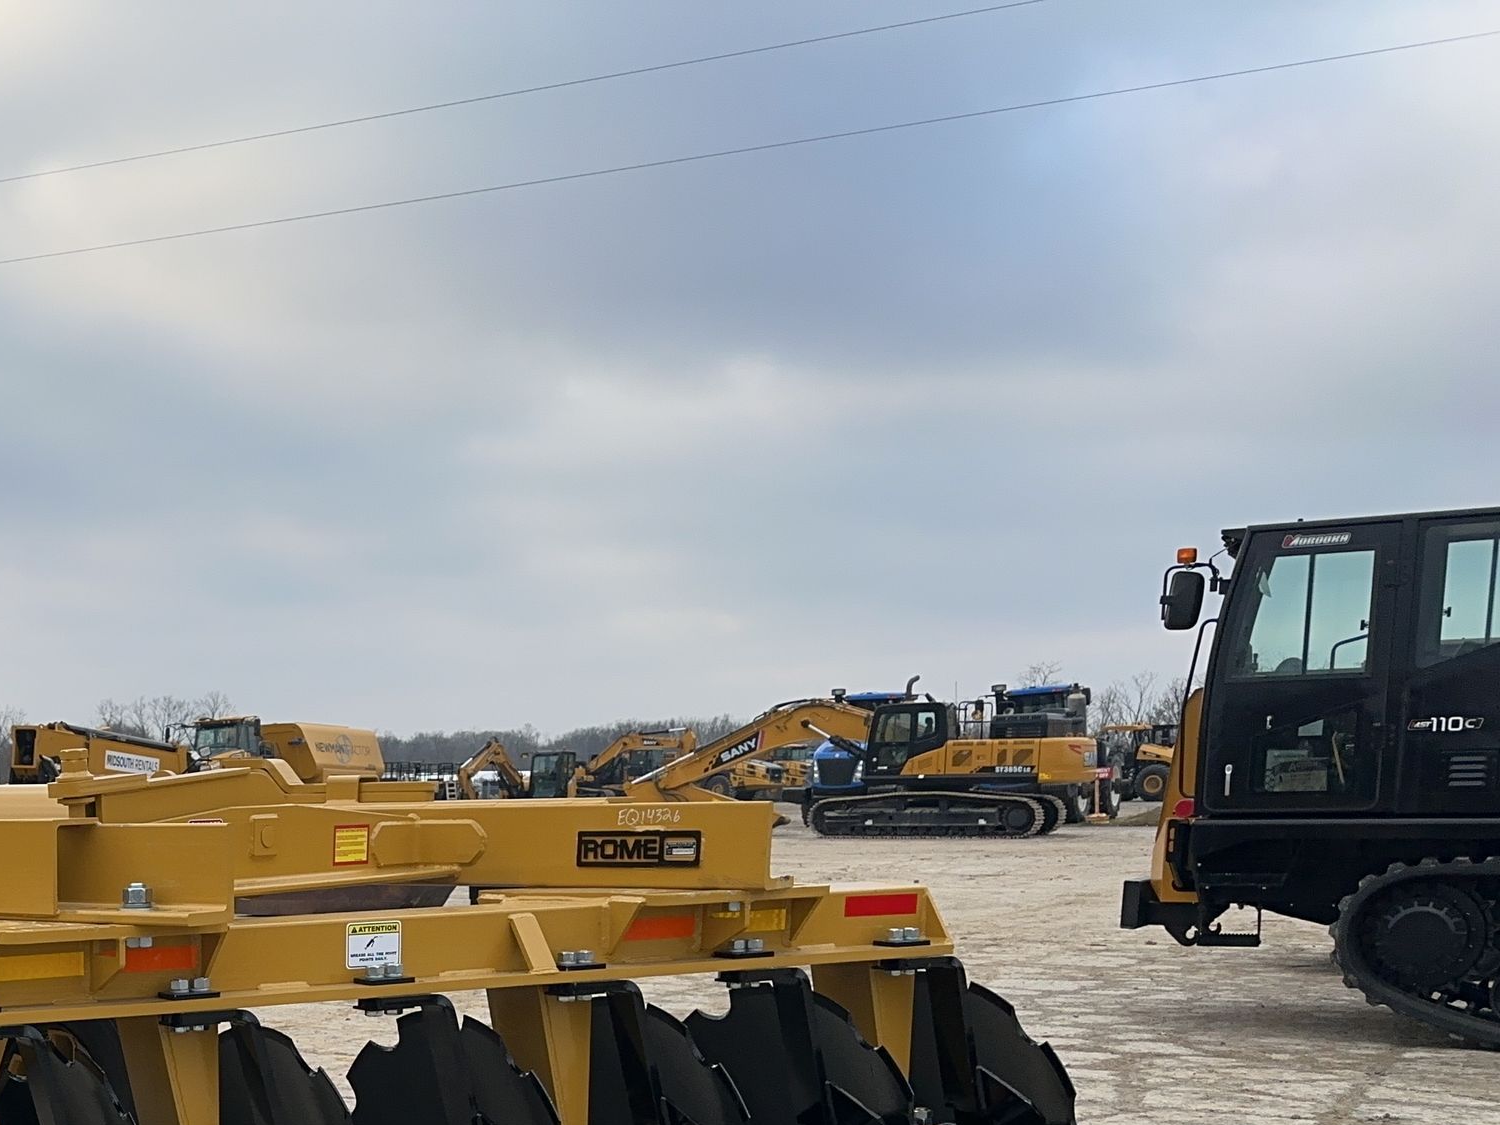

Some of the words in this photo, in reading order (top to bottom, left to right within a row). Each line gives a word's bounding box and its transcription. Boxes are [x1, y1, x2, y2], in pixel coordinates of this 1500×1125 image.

[720, 737, 757, 762] SANY
[618, 808, 681, 826] EQ14326
[580, 838, 660, 861] ROME
[358, 925, 398, 933] ATTENTION
